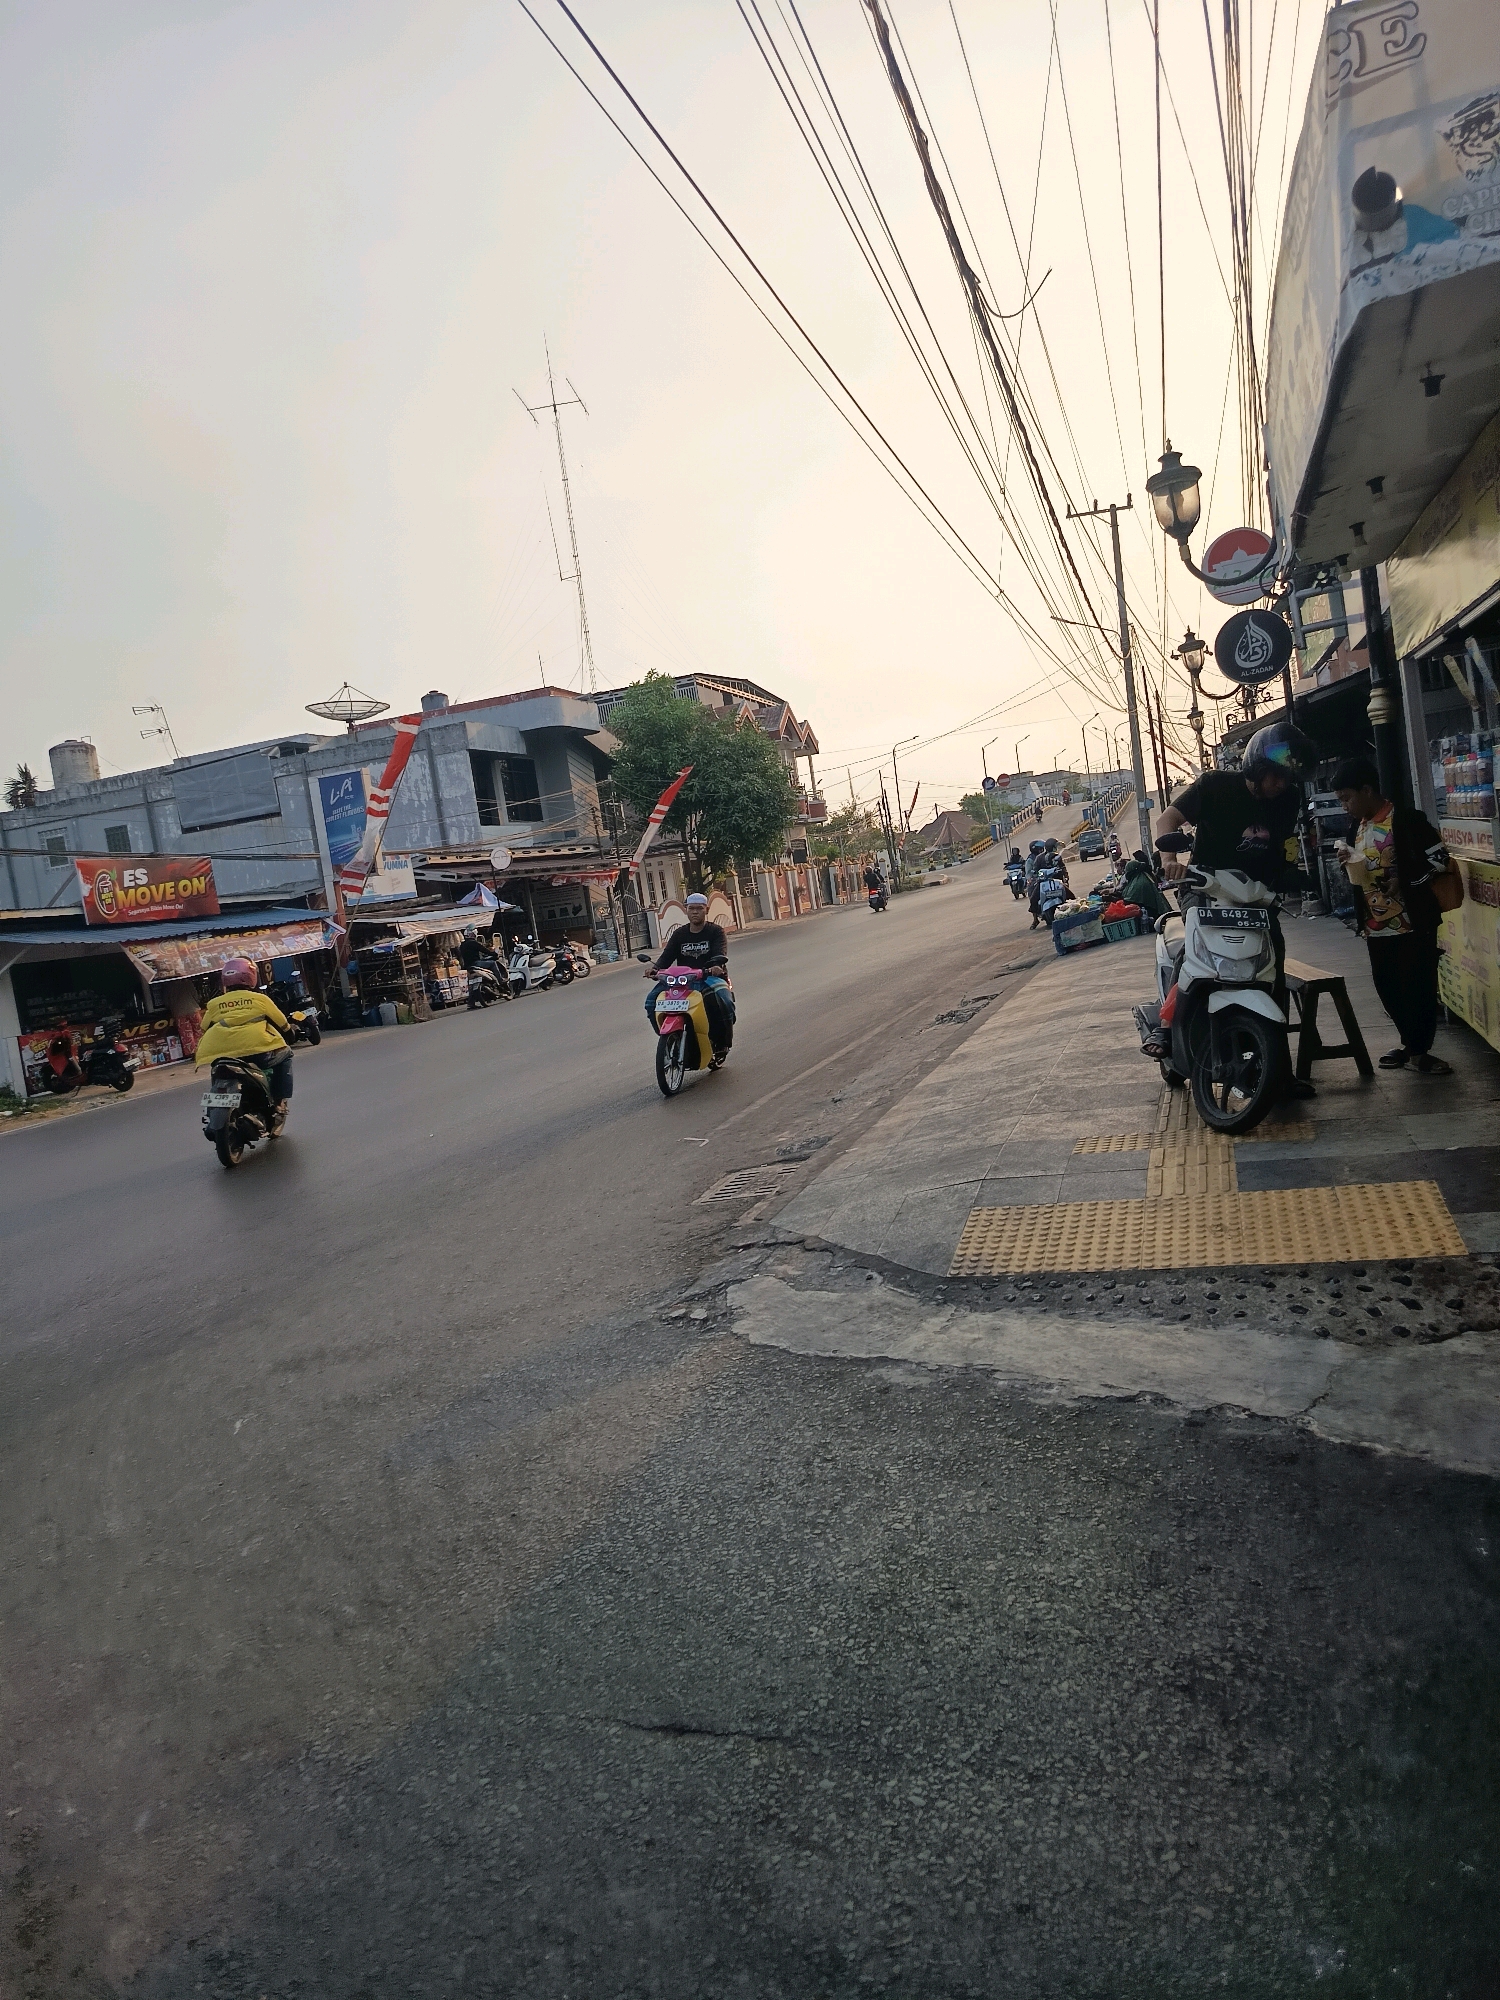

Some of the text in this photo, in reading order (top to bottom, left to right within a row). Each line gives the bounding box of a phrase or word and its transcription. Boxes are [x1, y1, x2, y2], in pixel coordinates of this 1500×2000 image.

[123, 868, 148, 887] ES
[117, 876, 206, 909] MOVE ON
[1199, 909, 1266, 919] DA 6482 V
[218, 997, 253, 1010] maxim
